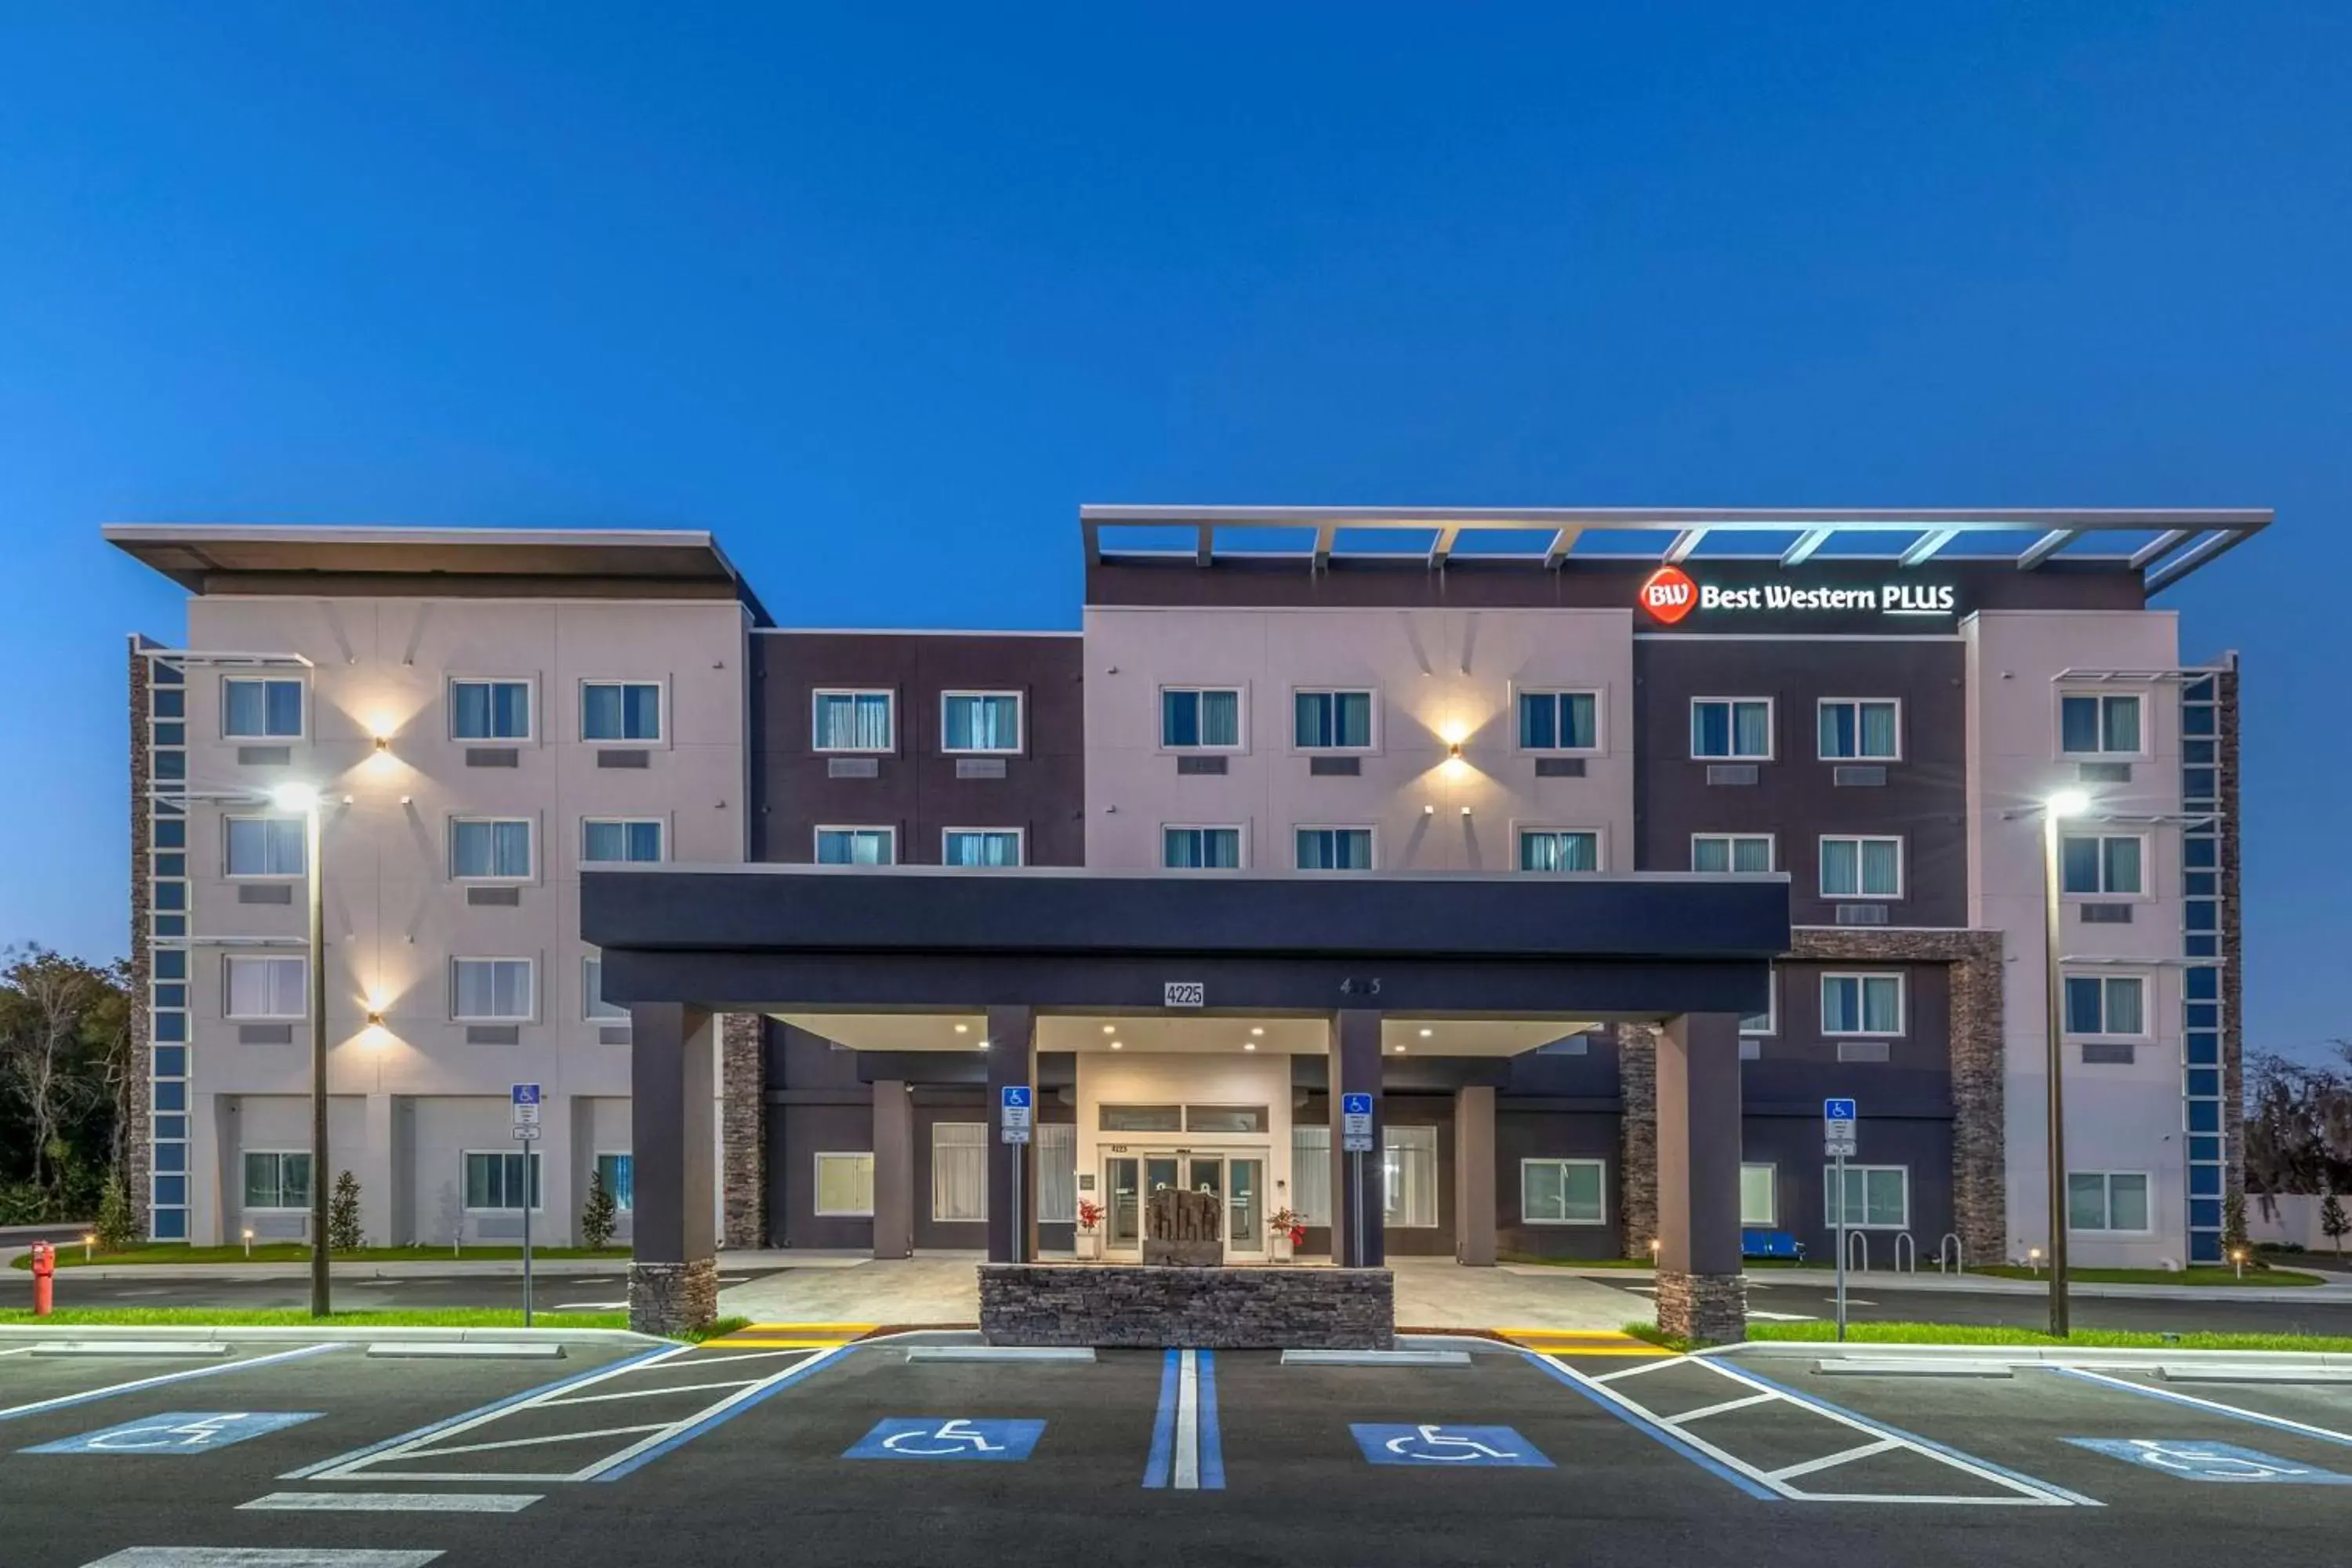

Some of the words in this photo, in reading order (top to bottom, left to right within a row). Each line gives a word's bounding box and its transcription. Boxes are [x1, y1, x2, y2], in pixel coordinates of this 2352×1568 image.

[1649, 584, 1689, 606] BW
[1700, 585, 1760, 609] Best
[1765, 585, 1875, 609] Western
[1882, 585, 1955, 609] PLUS
[1167, 985, 1202, 1004] 4225
[1340, 978, 1381, 995] 45
